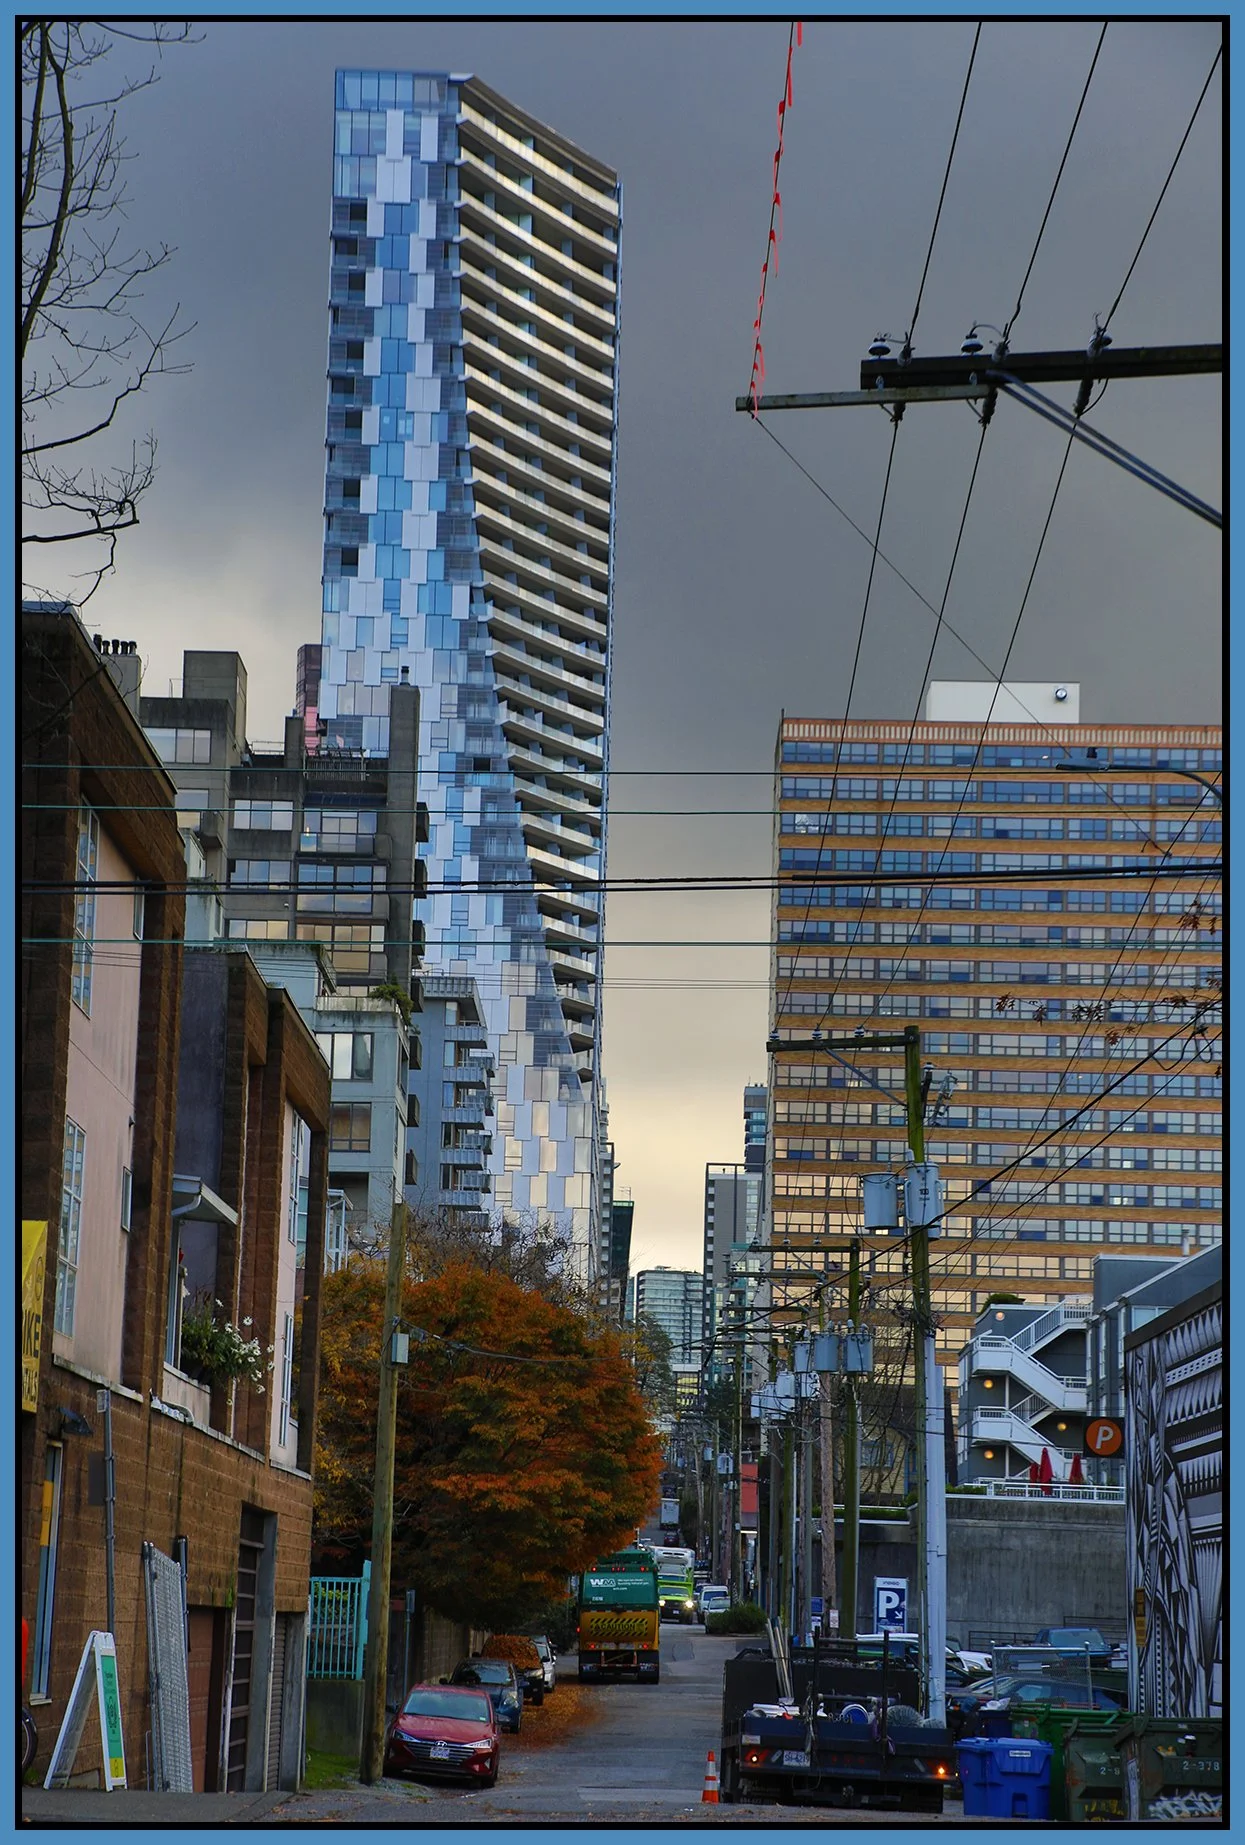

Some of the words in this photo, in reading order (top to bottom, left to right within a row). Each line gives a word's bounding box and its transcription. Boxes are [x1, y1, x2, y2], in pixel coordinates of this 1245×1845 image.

[22, 1309, 41, 1358] IKE
[1096, 1425, 1114, 1450] P
[879, 1590, 900, 1618] P
